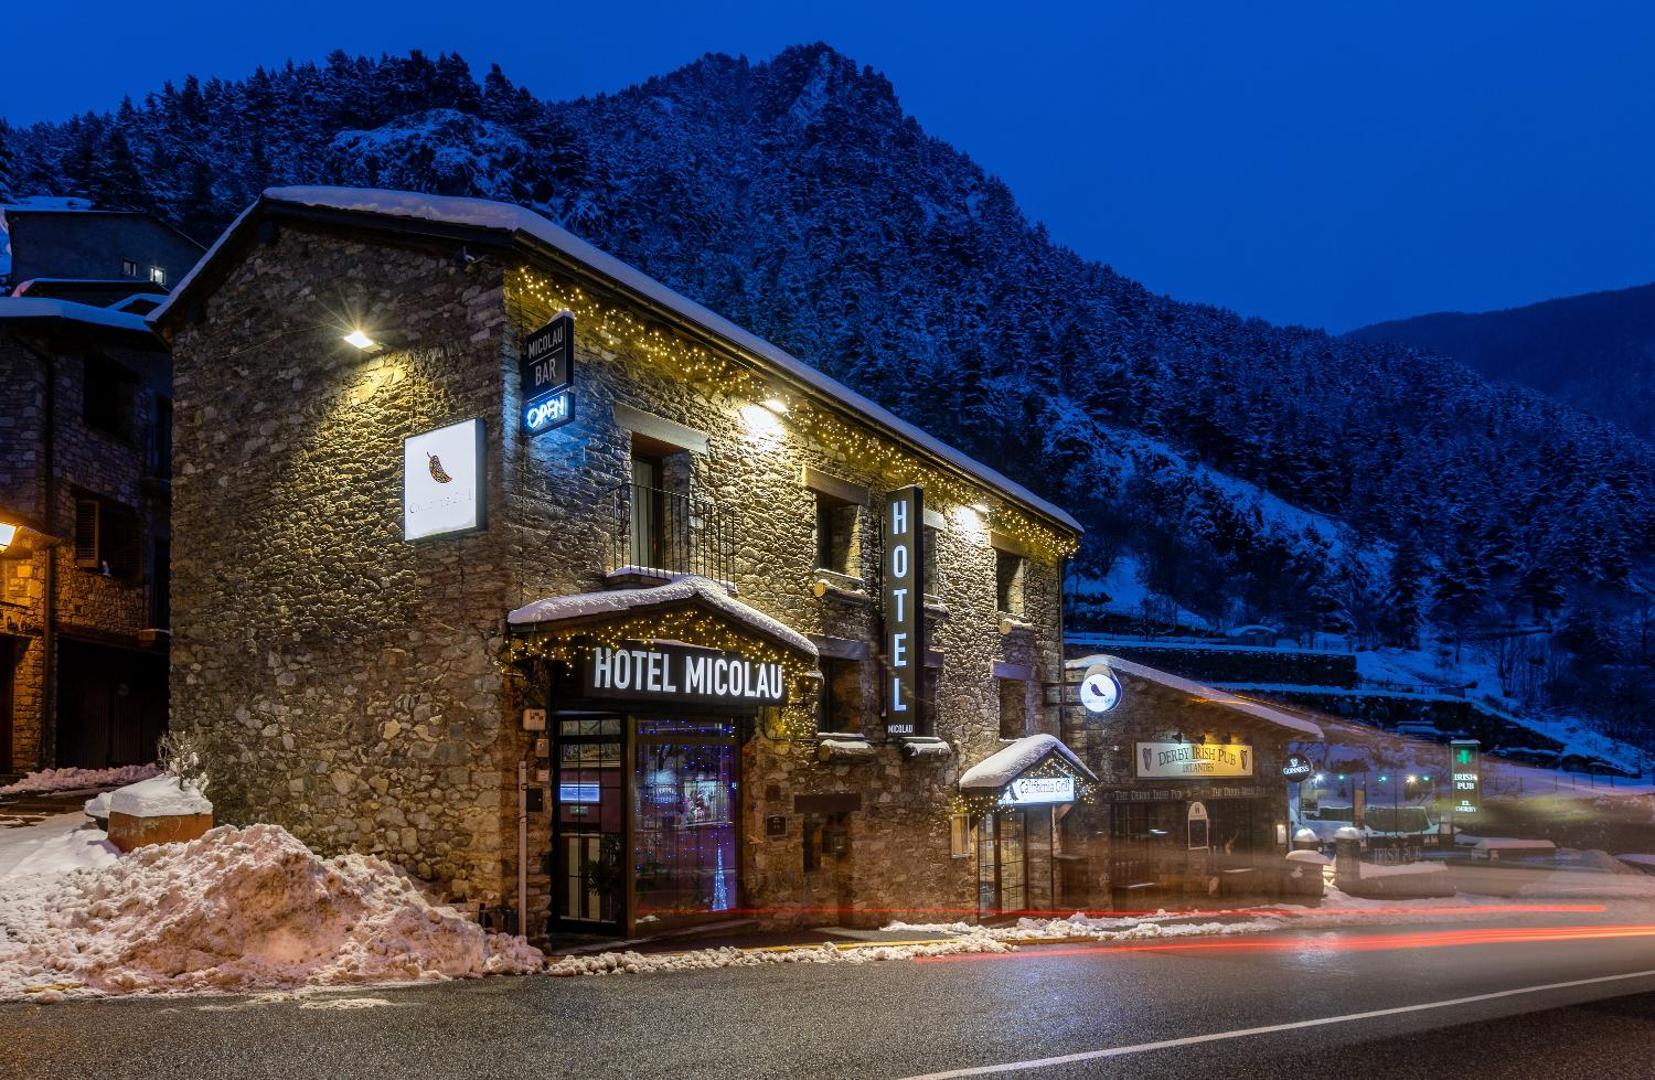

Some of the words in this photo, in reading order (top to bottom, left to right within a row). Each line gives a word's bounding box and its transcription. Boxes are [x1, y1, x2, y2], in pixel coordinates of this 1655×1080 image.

[528, 326, 564, 360] MICOLAU
[535, 358, 557, 387] BAR
[526, 395, 566, 429] OPEN
[892, 500, 908, 712] HOTEL
[593, 647, 677, 693] HOTEL
[685, 655, 783, 700] MICOLAU
[887, 724, 914, 734] MICOLAU
[1158, 747, 1190, 767] DERBY
[1191, 746, 1217, 762] IRISH
[1218, 748, 1237, 767] PUB
[1456, 782, 1475, 790] PUB
